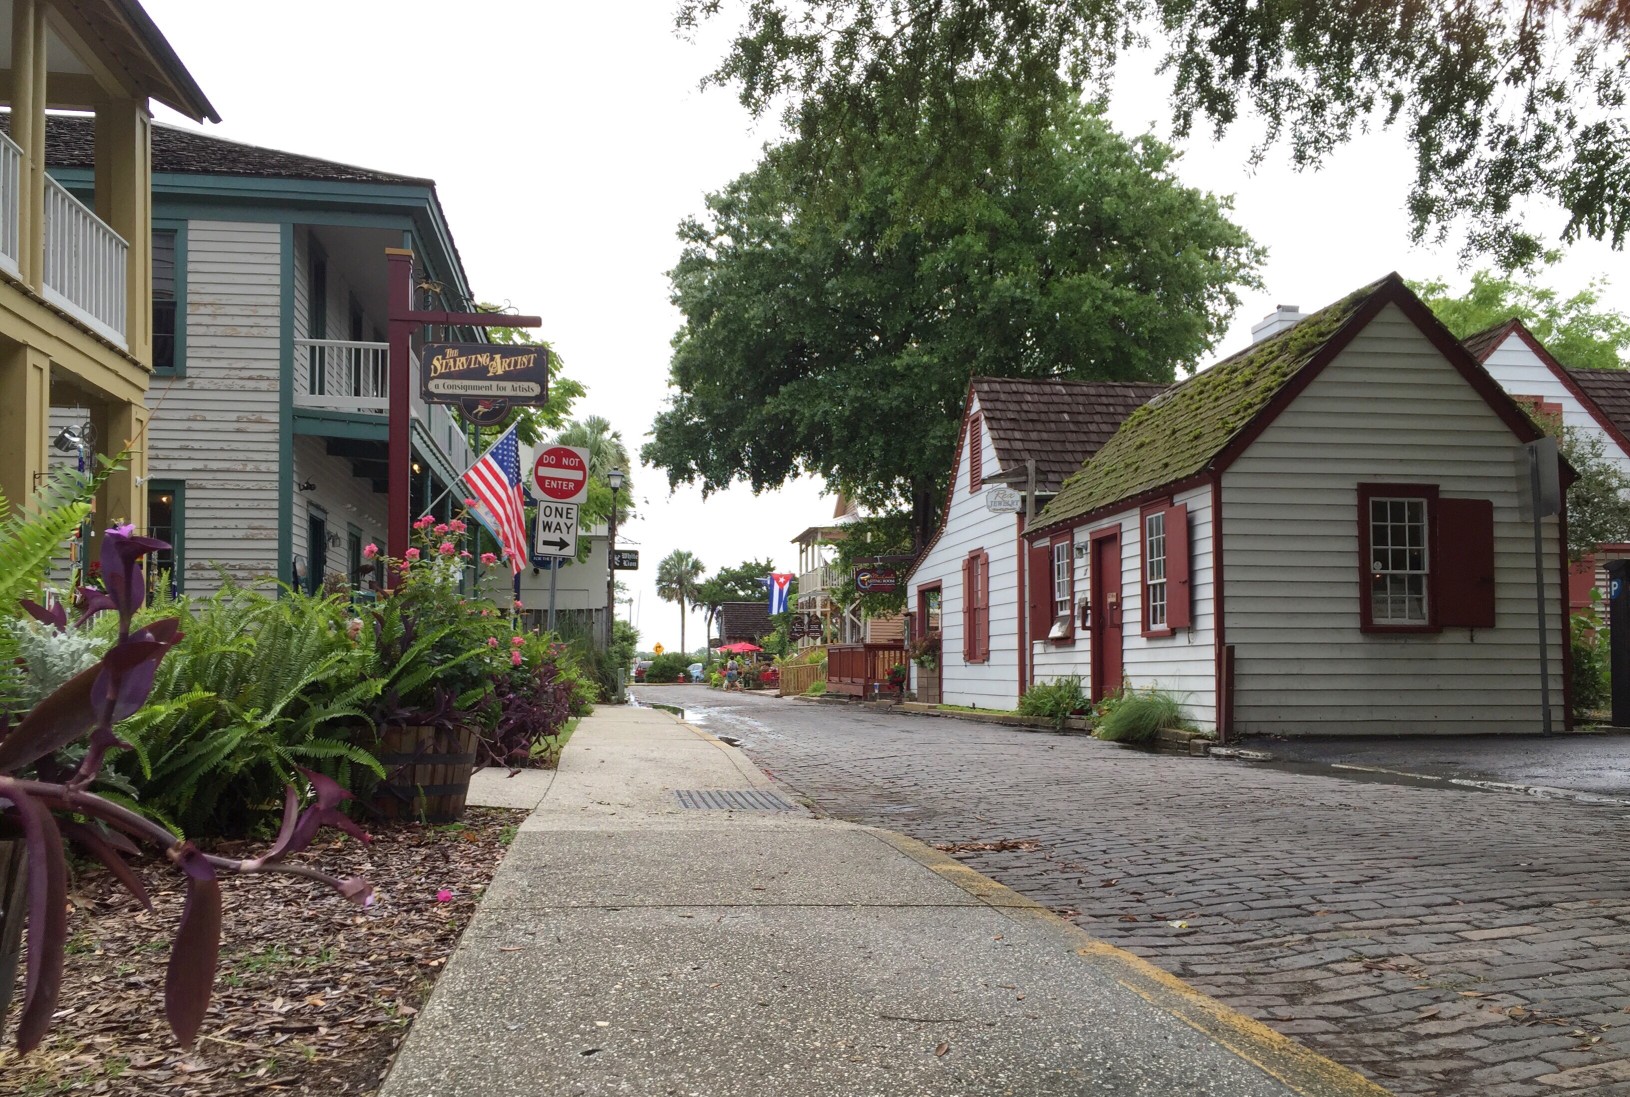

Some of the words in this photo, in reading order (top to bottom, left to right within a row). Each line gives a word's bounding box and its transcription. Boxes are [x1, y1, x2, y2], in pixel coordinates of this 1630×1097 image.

[430, 352, 490, 377] STARVING
[487, 353, 538, 376] ARTIST
[442, 382, 493, 392] Consignment
[496, 383, 507, 391] for
[511, 384, 535, 393] Artists
[543, 454, 556, 464] DO
[562, 457, 580, 467] NOT
[545, 479, 575, 490] ENTER
[543, 505, 574, 520] ONE
[542, 520, 574, 535] WAY
[1611, 581, 1619, 596] P
